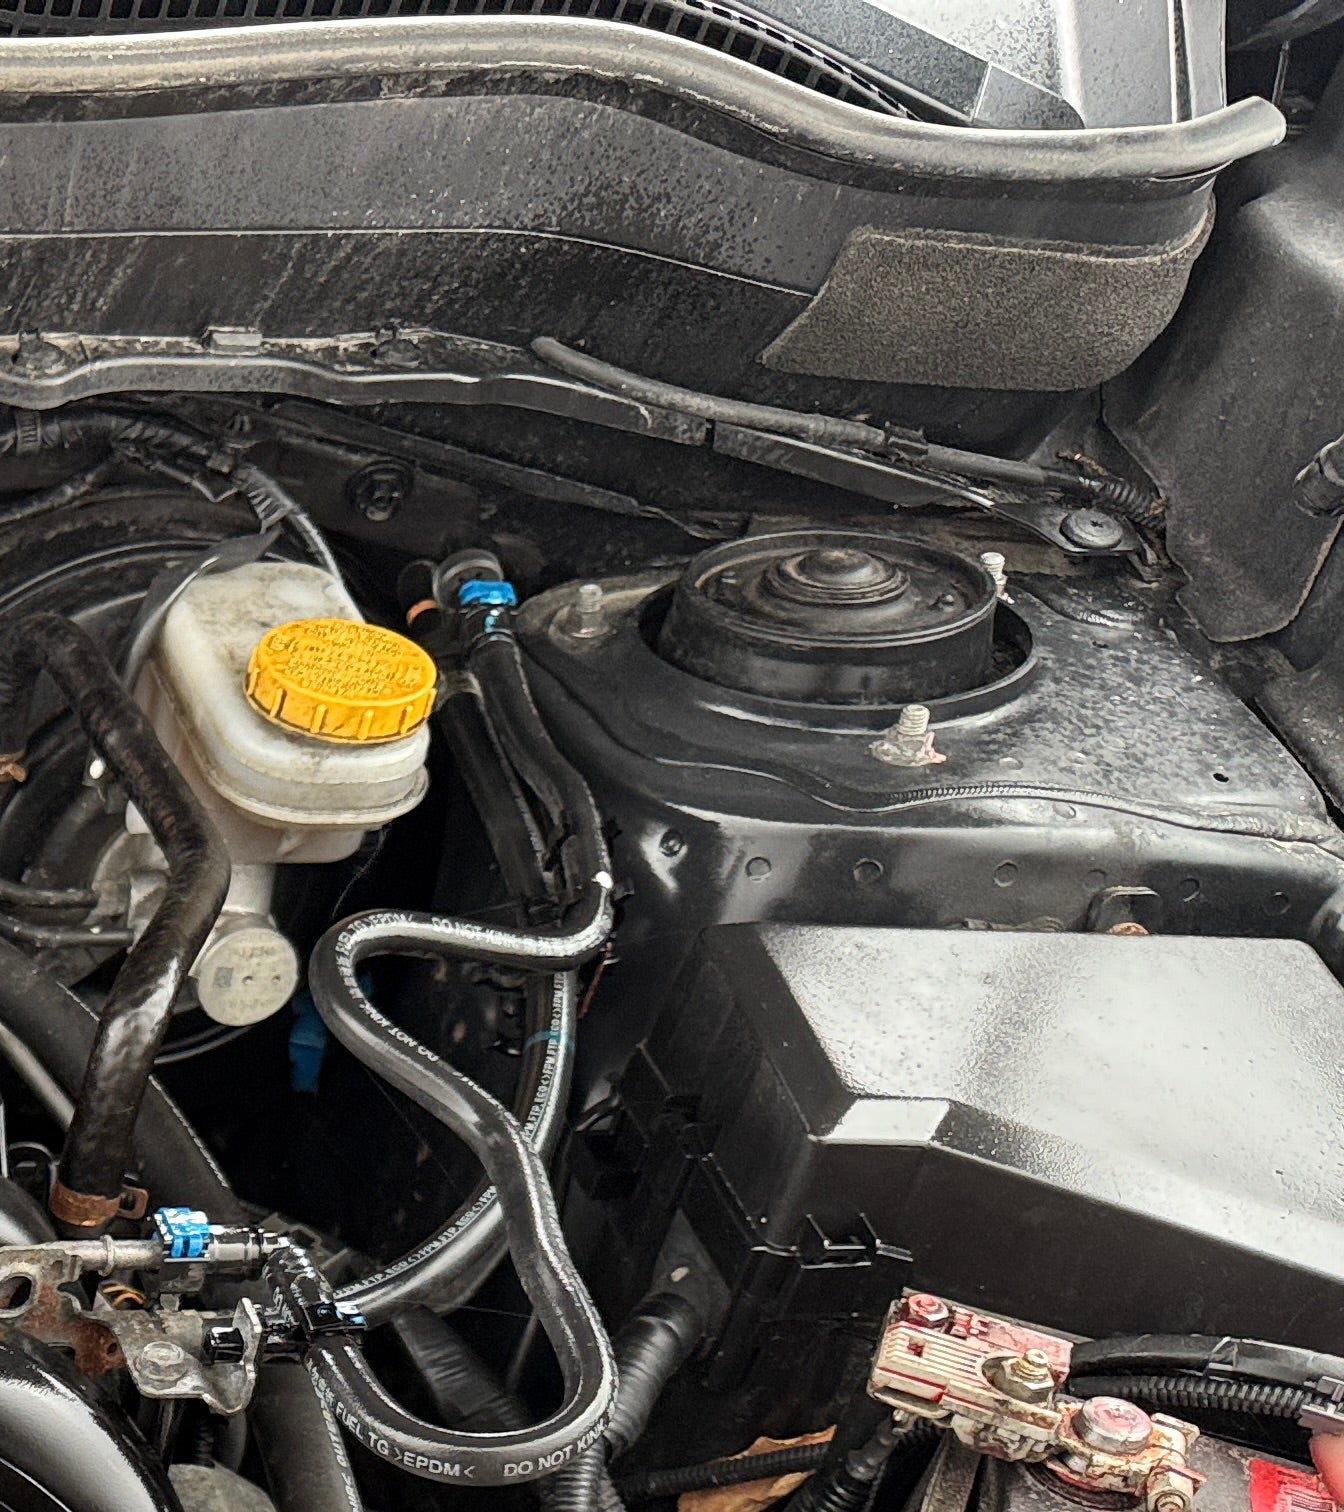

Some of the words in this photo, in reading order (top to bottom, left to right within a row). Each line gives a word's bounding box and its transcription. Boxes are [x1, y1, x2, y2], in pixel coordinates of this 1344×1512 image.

[336, 1402, 364, 1445] FUEL
[368, 1432, 390, 1458] TG
[394, 1447, 475, 1479] >EPDM<
[503, 1455, 534, 1478] DO
[538, 1444, 572, 1471] NOT
